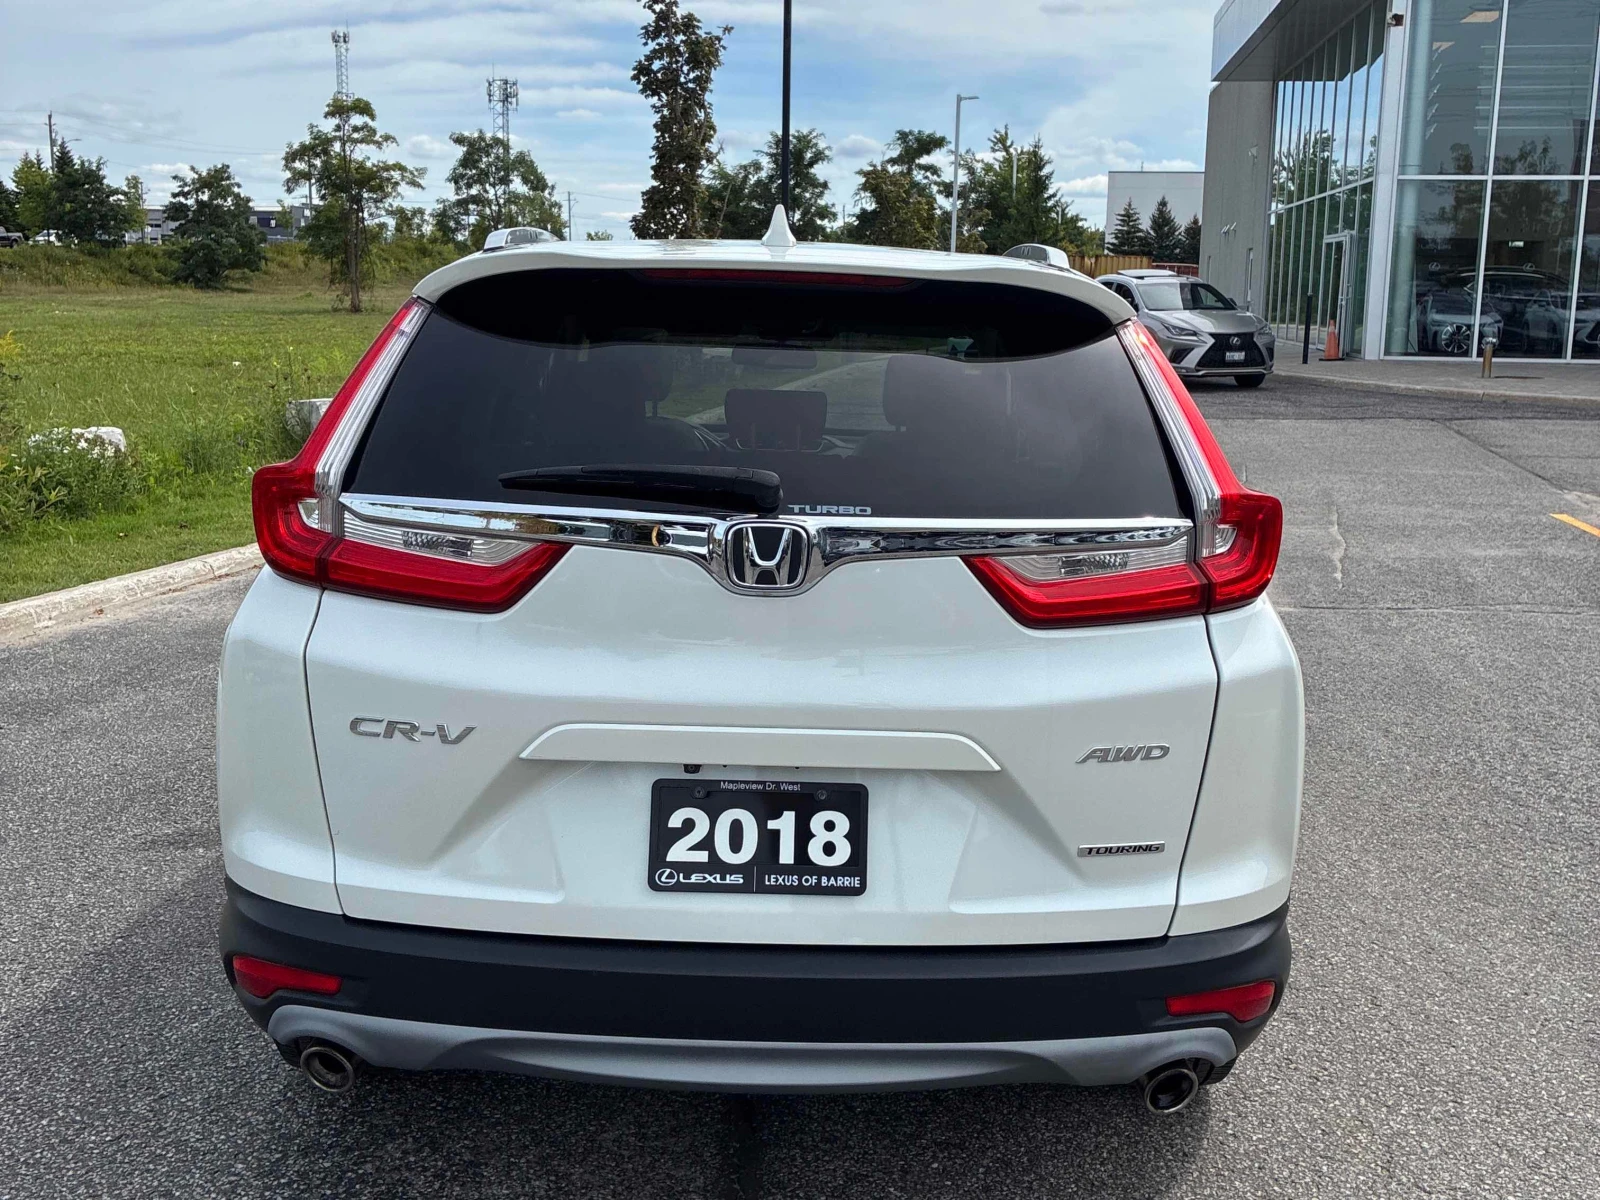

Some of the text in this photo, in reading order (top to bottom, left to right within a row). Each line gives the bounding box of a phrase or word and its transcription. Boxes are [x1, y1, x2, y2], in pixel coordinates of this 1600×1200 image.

[787, 504, 872, 515] TURBO
[349, 717, 478, 745] CR-V
[1075, 743, 1170, 764] AWD
[720, 781, 801, 791] Mapleview Dr. West
[665, 807, 851, 867] 2018
[1084, 844, 1160, 855] TOURING
[679, 873, 744, 884] LEXUS
[764, 874, 861, 887] LEXUS OF BARRIE
